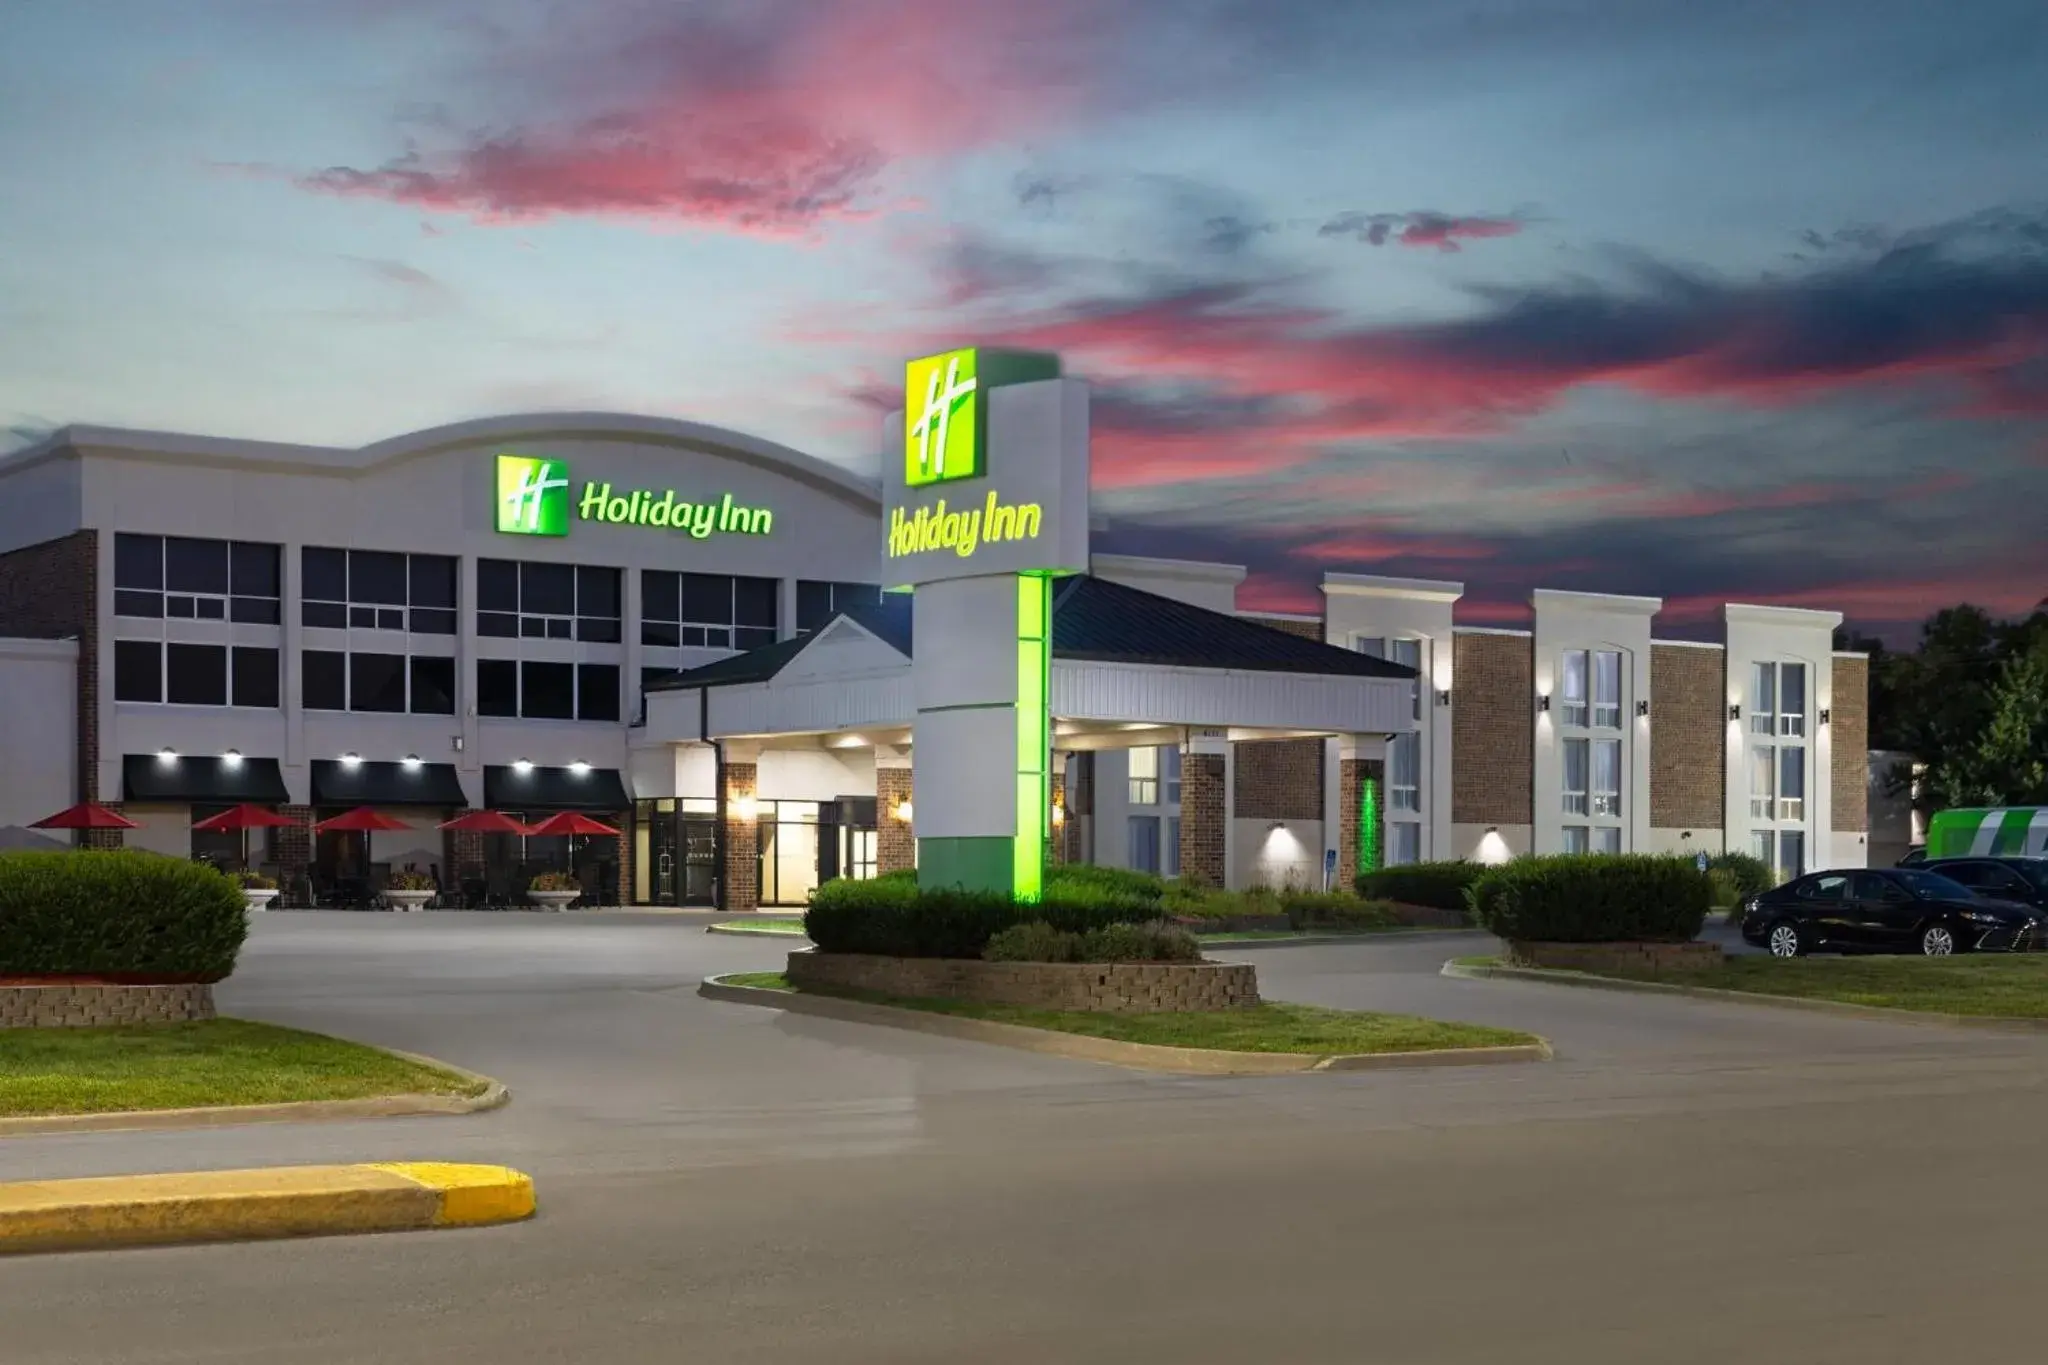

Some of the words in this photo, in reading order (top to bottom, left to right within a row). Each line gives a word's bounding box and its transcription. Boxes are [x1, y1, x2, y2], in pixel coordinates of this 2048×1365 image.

[579, 481, 716, 539] Holiday
[719, 493, 773, 535] Inn
[888, 499, 981, 558] Holiday
[982, 490, 1041, 543] Inn
